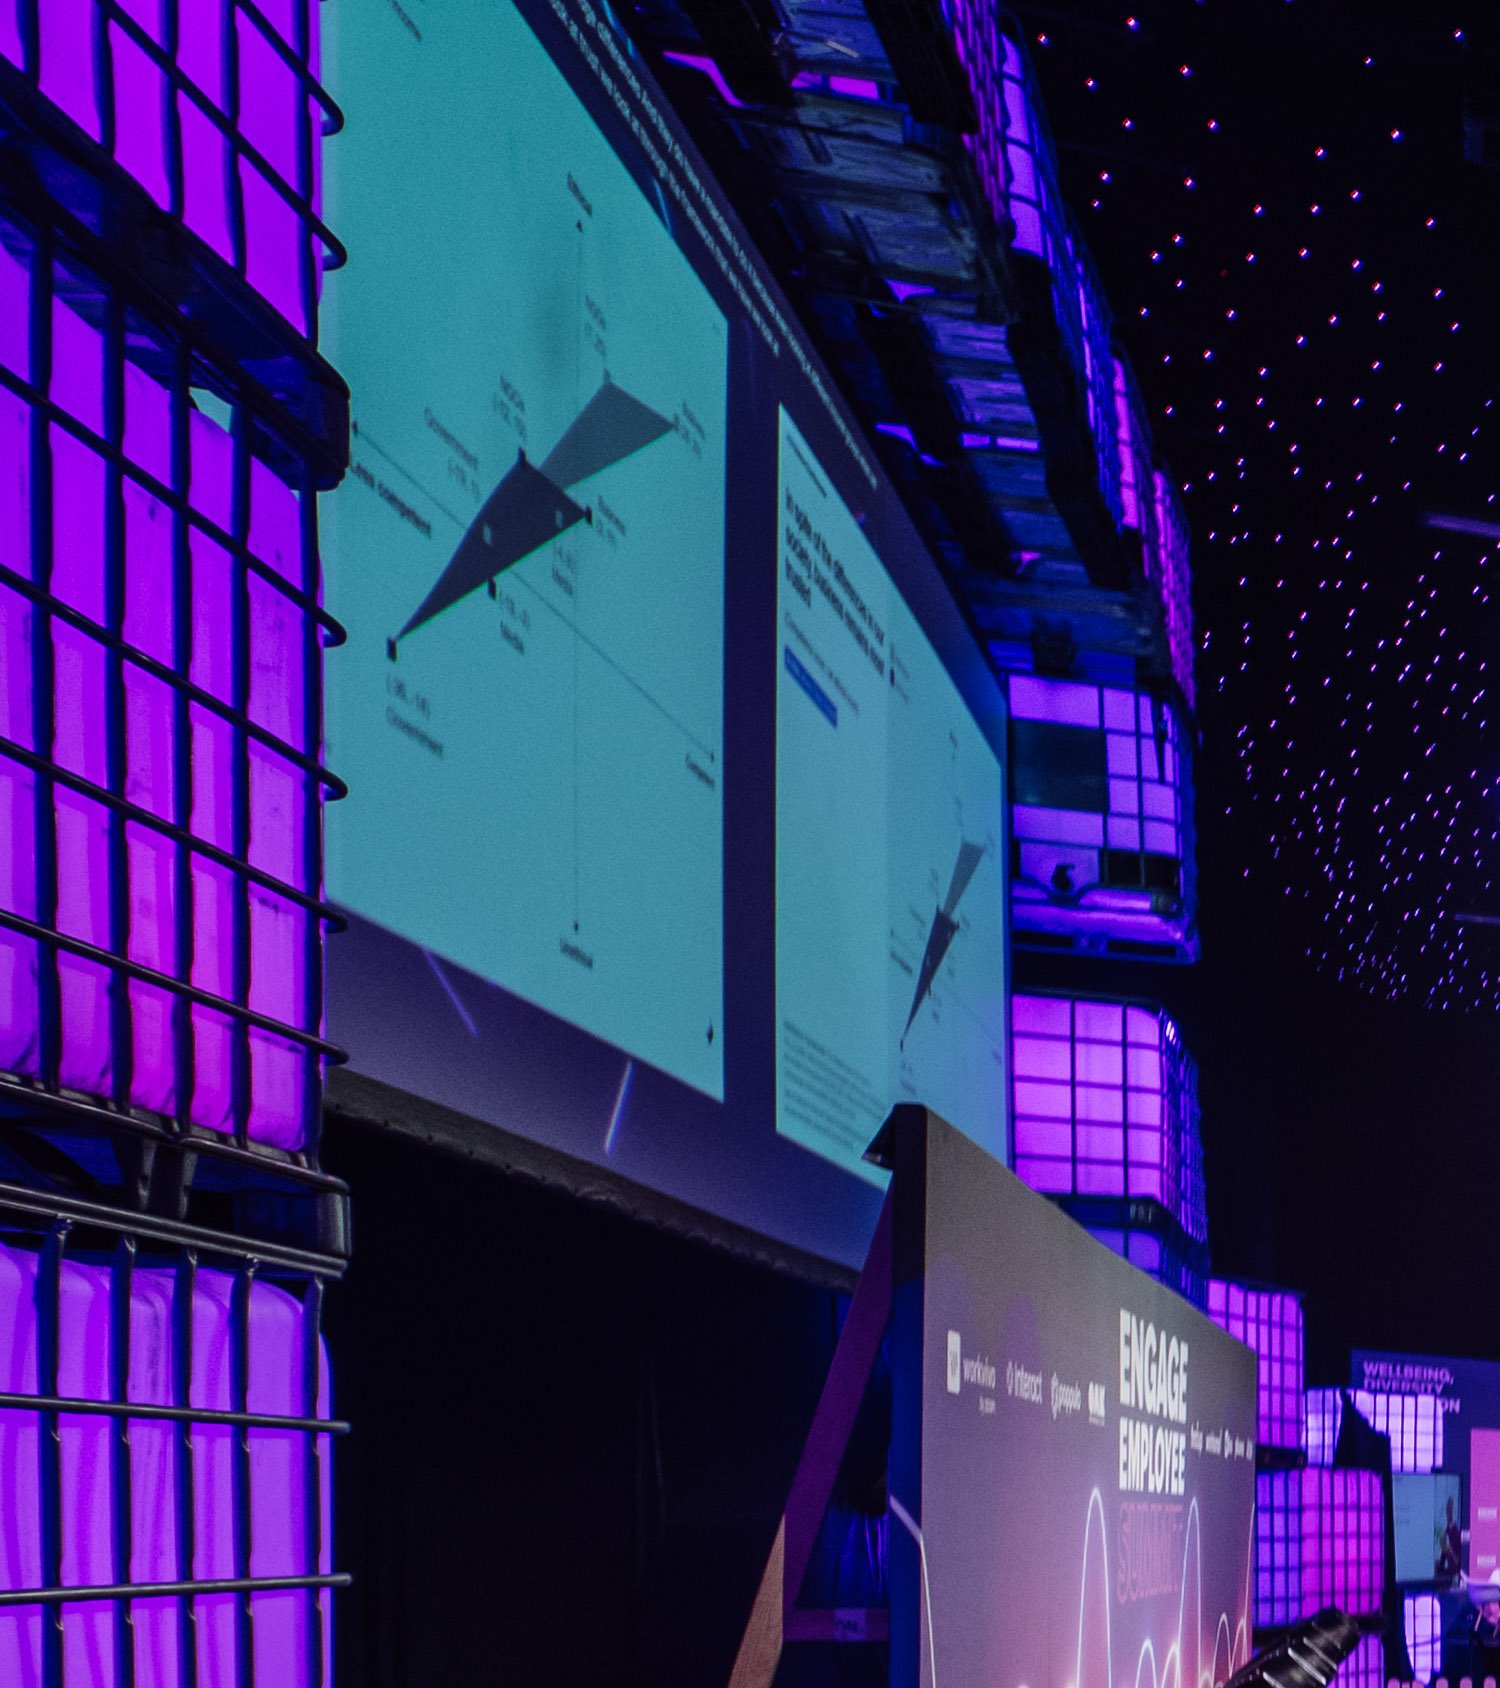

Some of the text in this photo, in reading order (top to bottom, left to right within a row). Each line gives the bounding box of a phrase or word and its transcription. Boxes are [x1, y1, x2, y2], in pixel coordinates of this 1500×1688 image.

[963, 1354, 996, 1390] workvivo
[1119, 1307, 1189, 1424] ENGAGE
[1363, 1360, 1455, 1386] WELLBEING,
[1119, 1416, 1187, 1496] EMPLOYEE
